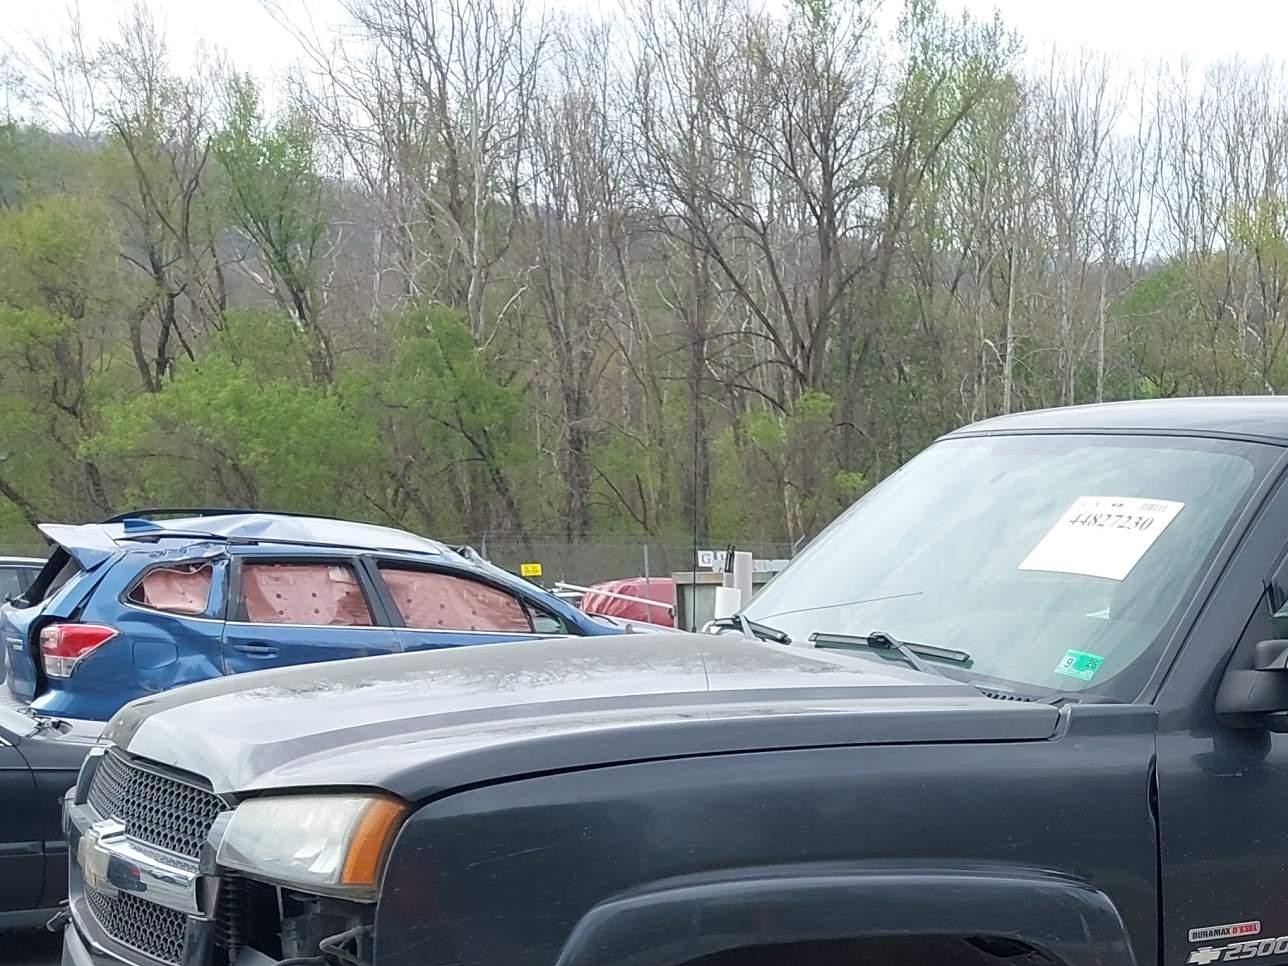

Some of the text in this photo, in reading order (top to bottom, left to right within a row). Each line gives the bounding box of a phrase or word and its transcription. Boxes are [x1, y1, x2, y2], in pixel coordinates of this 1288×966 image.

[1068, 513, 1154, 531] 44827230
[1192, 922, 1259, 940] DURAMAX DESEL
